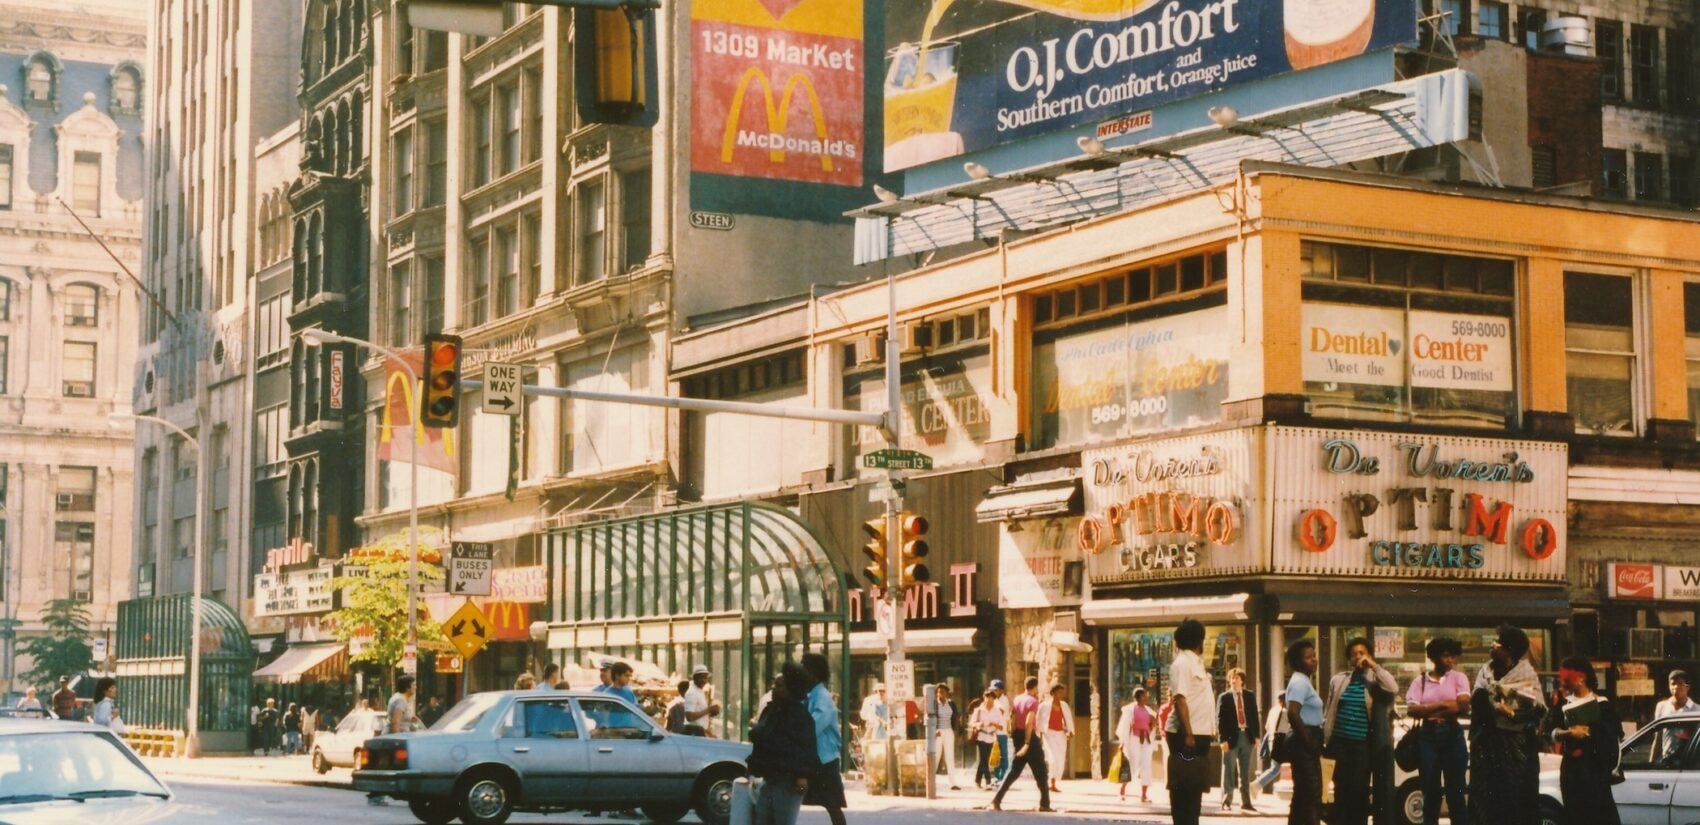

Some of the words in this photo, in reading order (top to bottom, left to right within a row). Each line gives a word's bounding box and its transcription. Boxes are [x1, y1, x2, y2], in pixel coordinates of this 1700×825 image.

[702, 30, 759, 58] 1309
[1006, 38, 1064, 99] O.J.
[1065, 0, 1239, 75] Comfort
[1176, 48, 1202, 68] and
[997, 93, 1083, 131] Southern
[1085, 71, 1169, 109] Comfort,
[1170, 63, 1221, 89] Orange
[1221, 53, 1257, 81] Juice
[1097, 114, 1151, 137] INTERSTATE
[737, 130, 856, 158] McDonald's
[694, 213, 730, 226] STEEN
[1311, 327, 1388, 356] Dental
[1413, 334, 1488, 362] Center
[490, 366, 516, 379] ONE
[1142, 354, 1220, 396] Center
[1367, 361, 1384, 376] the
[1412, 364, 1445, 379] Good
[489, 381, 516, 393] WAY
[888, 459, 911, 469] STREET
[1093, 457, 1126, 486] De
[1322, 439, 1380, 475] De
[1397, 443, 1534, 483] Voren's
[1079, 490, 1240, 554] OPTIMO
[1299, 487, 1558, 561] OPTIMO
[456, 560, 488, 569] BUSES
[1119, 542, 1199, 572] CIGARS
[1373, 540, 1486, 569] CIGARS
[348, 569, 370, 578] LIVE
[459, 571, 484, 580] ONLY
[891, 664, 906, 673] NO
